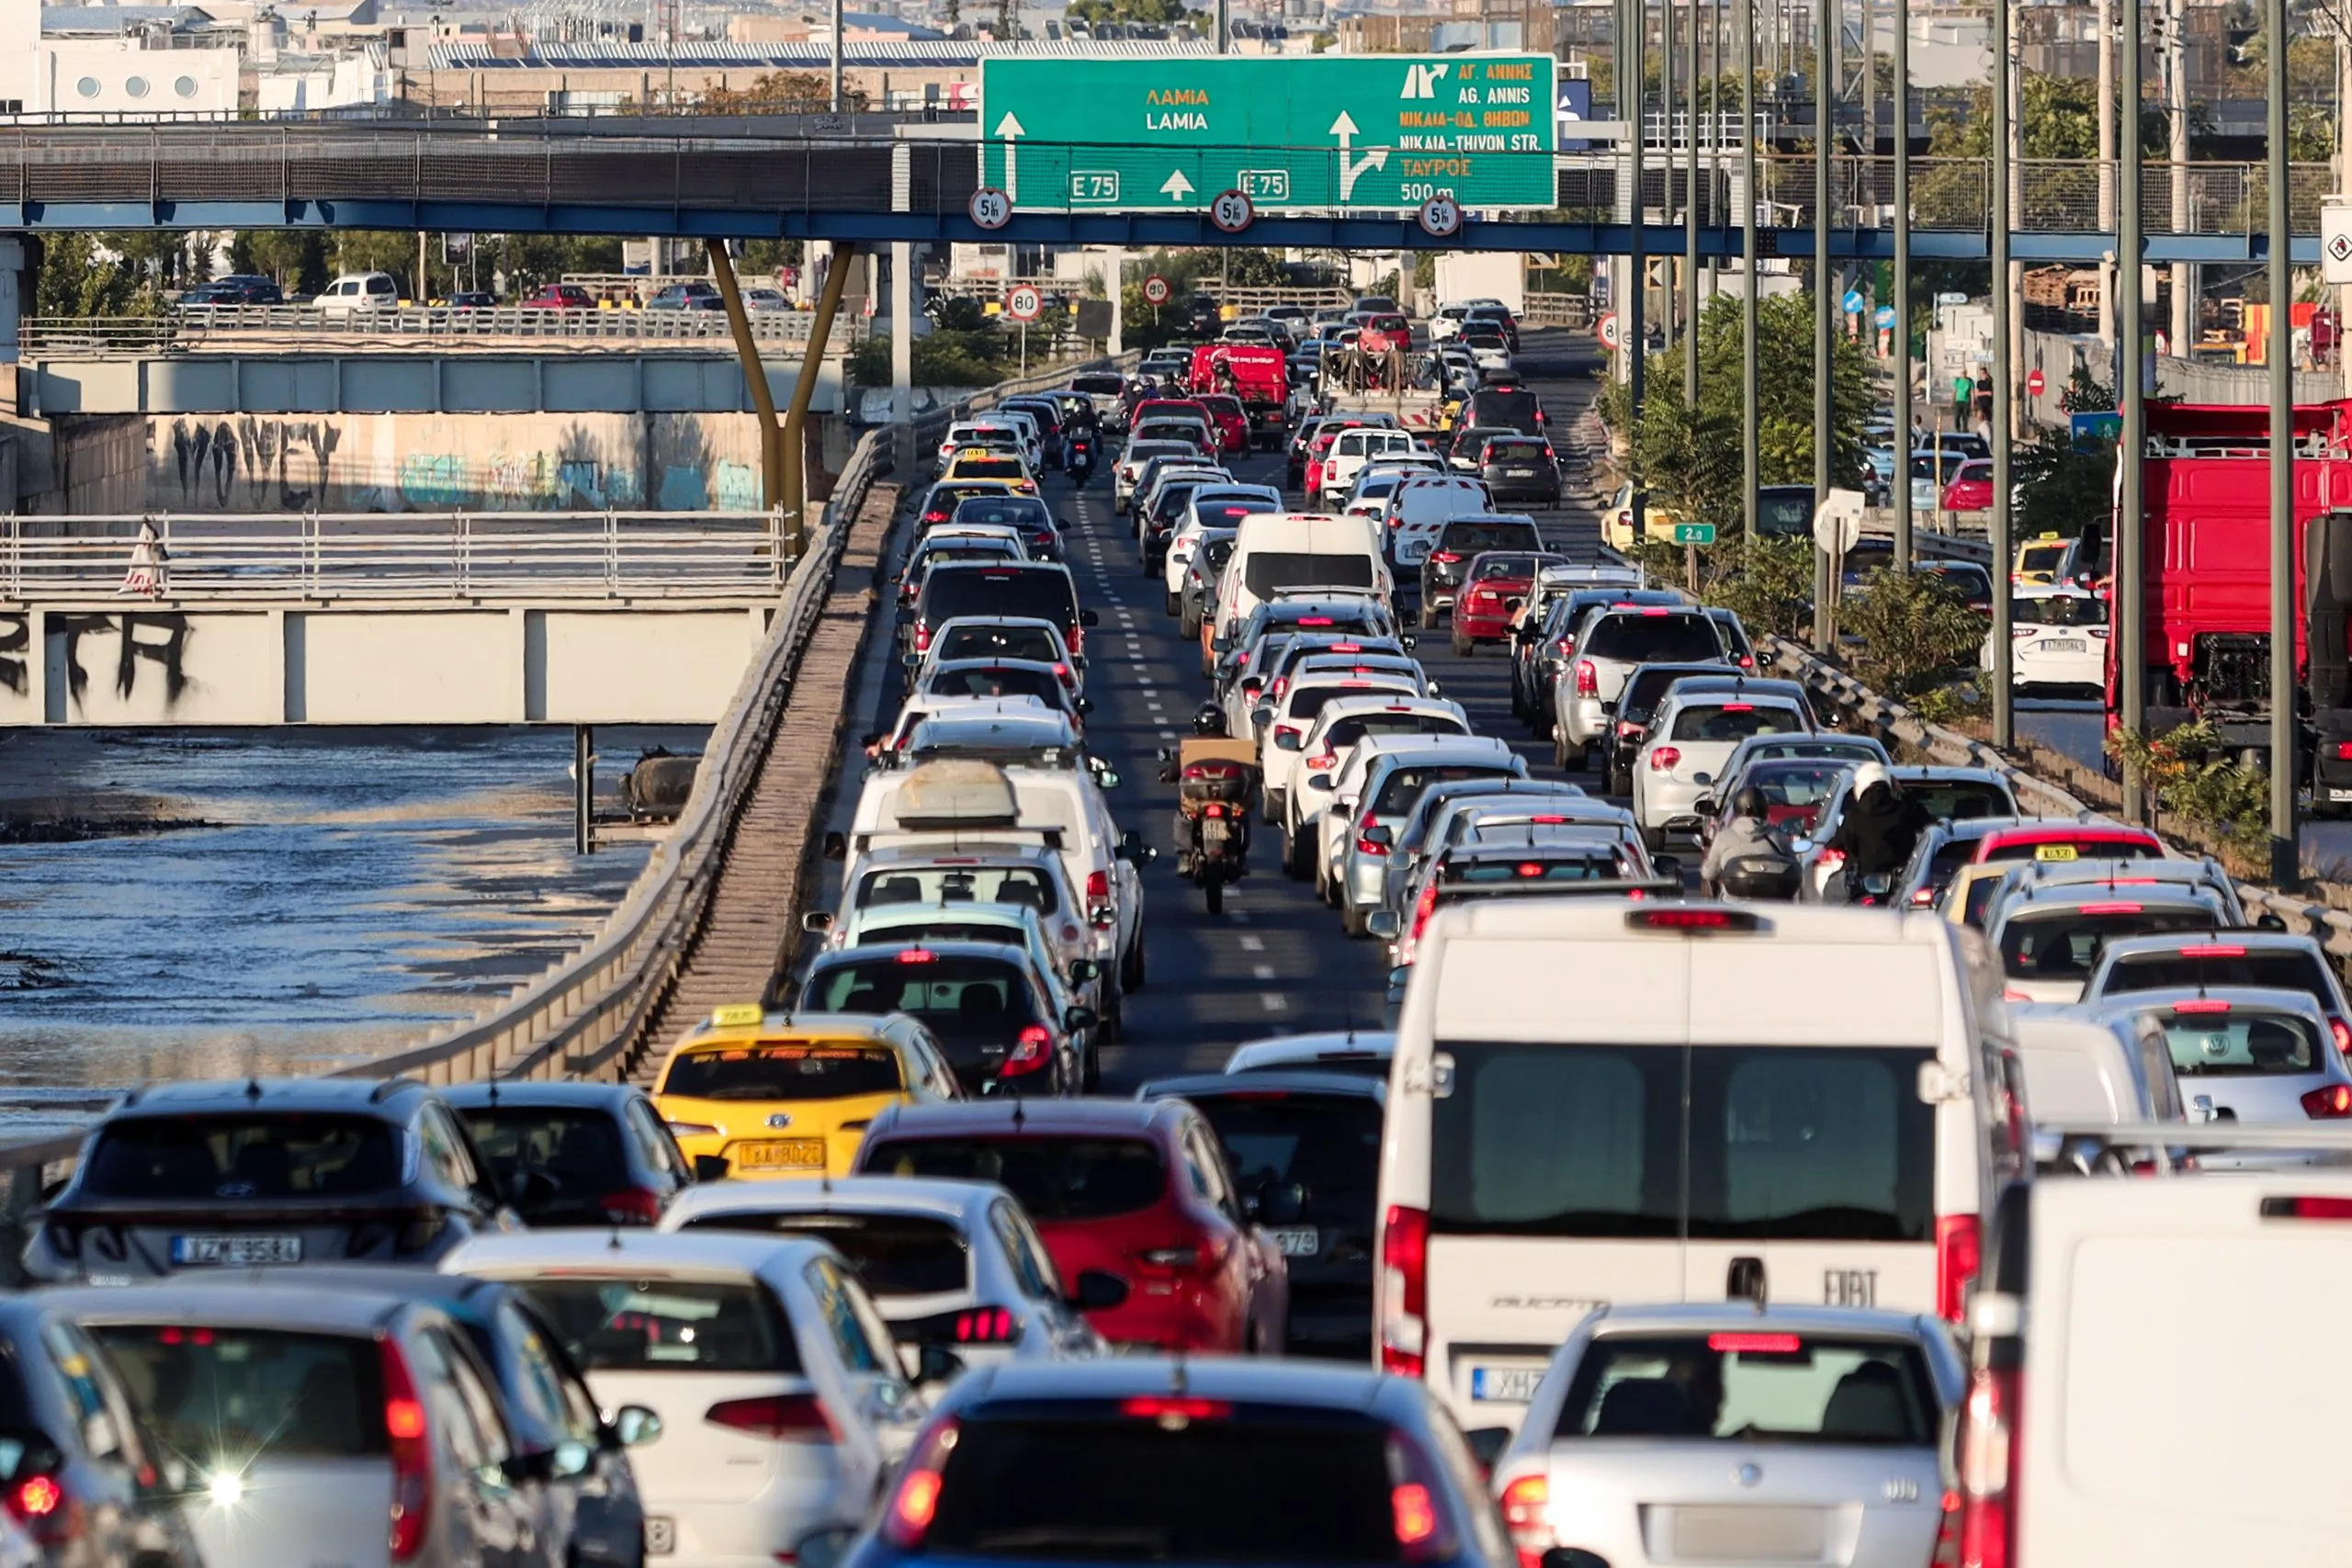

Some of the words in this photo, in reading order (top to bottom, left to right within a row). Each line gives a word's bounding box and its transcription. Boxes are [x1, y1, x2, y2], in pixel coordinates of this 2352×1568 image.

[1487, 63, 1533, 80] ΑΝΝΗΣ
[1147, 88, 1209, 106] ΛΑΜΙΑ
[1458, 87, 1481, 104] AG.
[1487, 87, 1530, 104] ANNIS
[1147, 112, 1208, 130] LAMIA
[1399, 135, 1505, 151] NIKAIA-THIVON
[1511, 134, 1543, 152] STR.
[1073, 176, 1085, 197] E
[1091, 176, 1114, 197] 75
[1243, 175, 1256, 195] E
[1261, 175, 1283, 195] 75
[1401, 183, 1433, 201] 500
[981, 199, 989, 216] 5
[1223, 202, 1231, 220] 5
[1431, 208, 1440, 223] 5
[1148, 284, 1164, 296] 80
[1014, 296, 1034, 310] 80
[1685, 527, 1702, 540] 2.0
[2044, 849, 2072, 859] TAXI
[1824, 1269, 1880, 1308] FIAT
